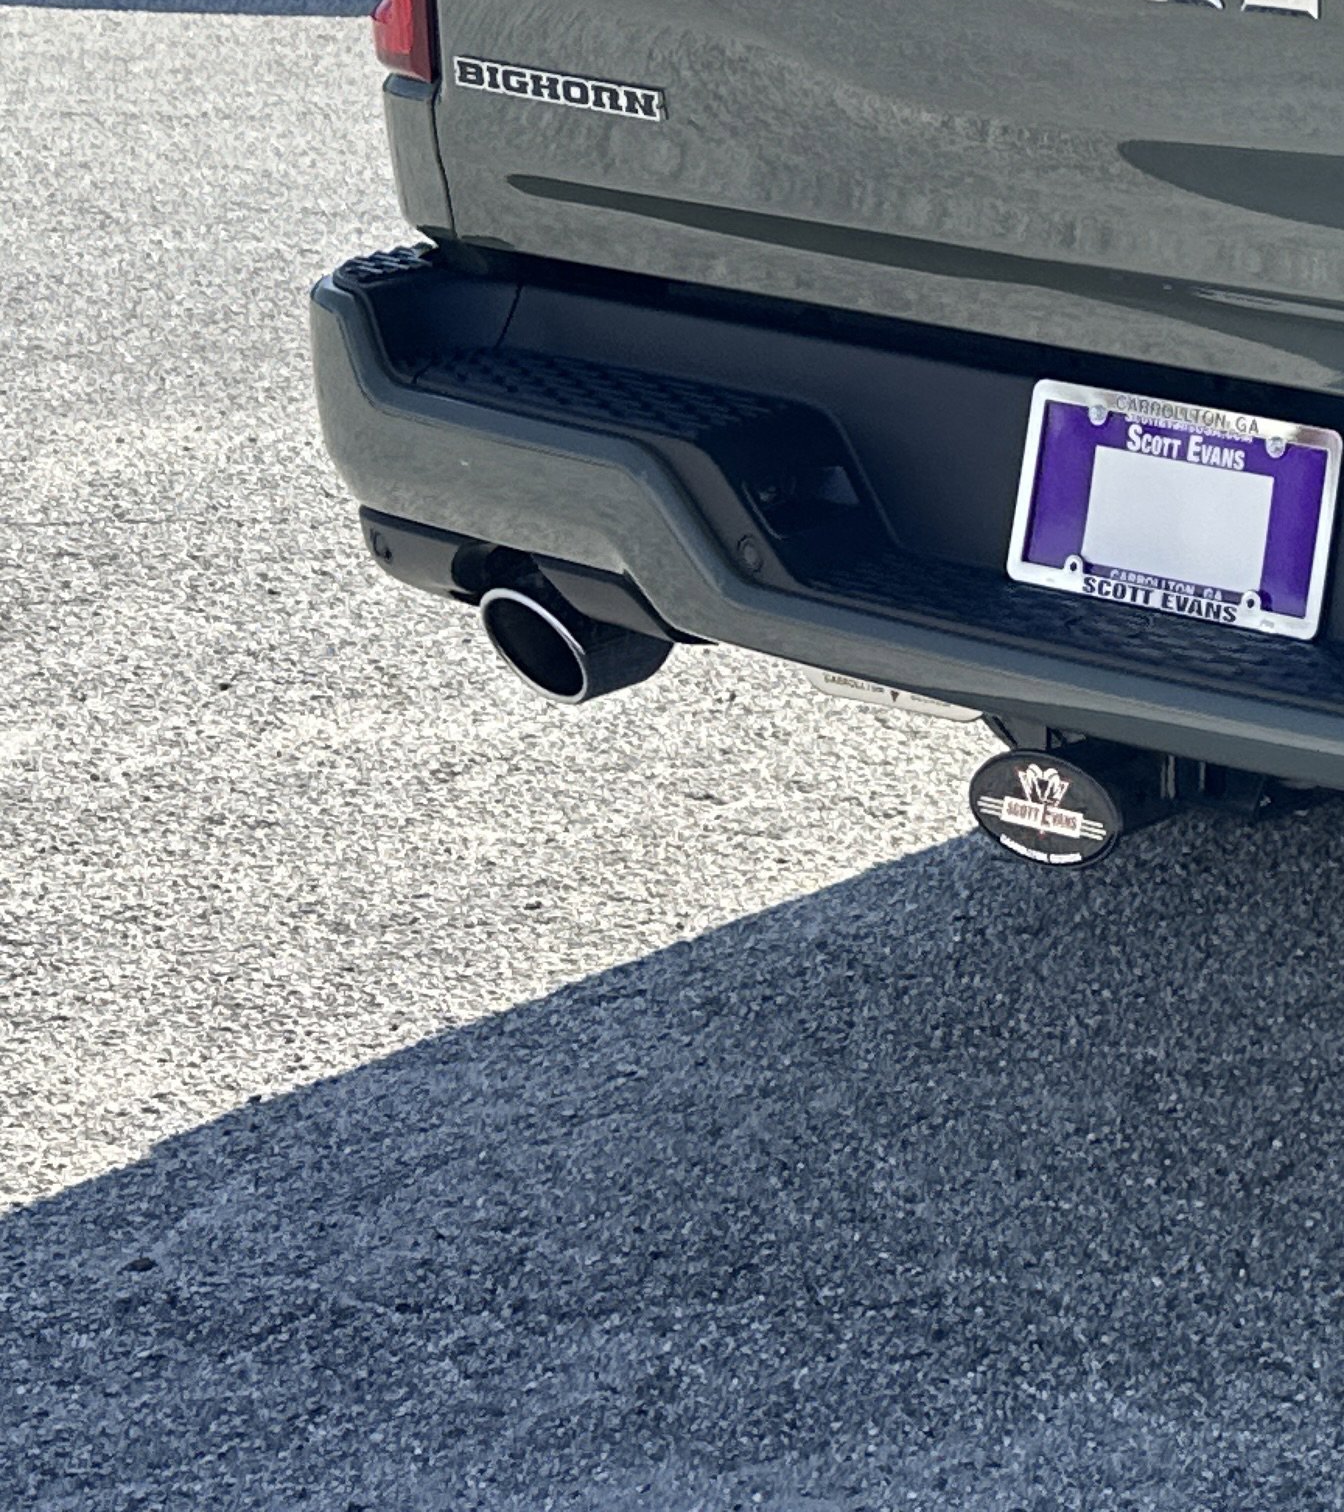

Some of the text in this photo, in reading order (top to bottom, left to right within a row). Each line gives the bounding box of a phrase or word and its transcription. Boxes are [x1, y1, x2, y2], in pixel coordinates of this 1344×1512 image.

[454, 56, 661, 121] BIGHORN
[1235, 416, 1260, 434] GA
[1083, 576, 1238, 623] SCOTT EVANS
[1006, 800, 1040, 821] SCOTT
